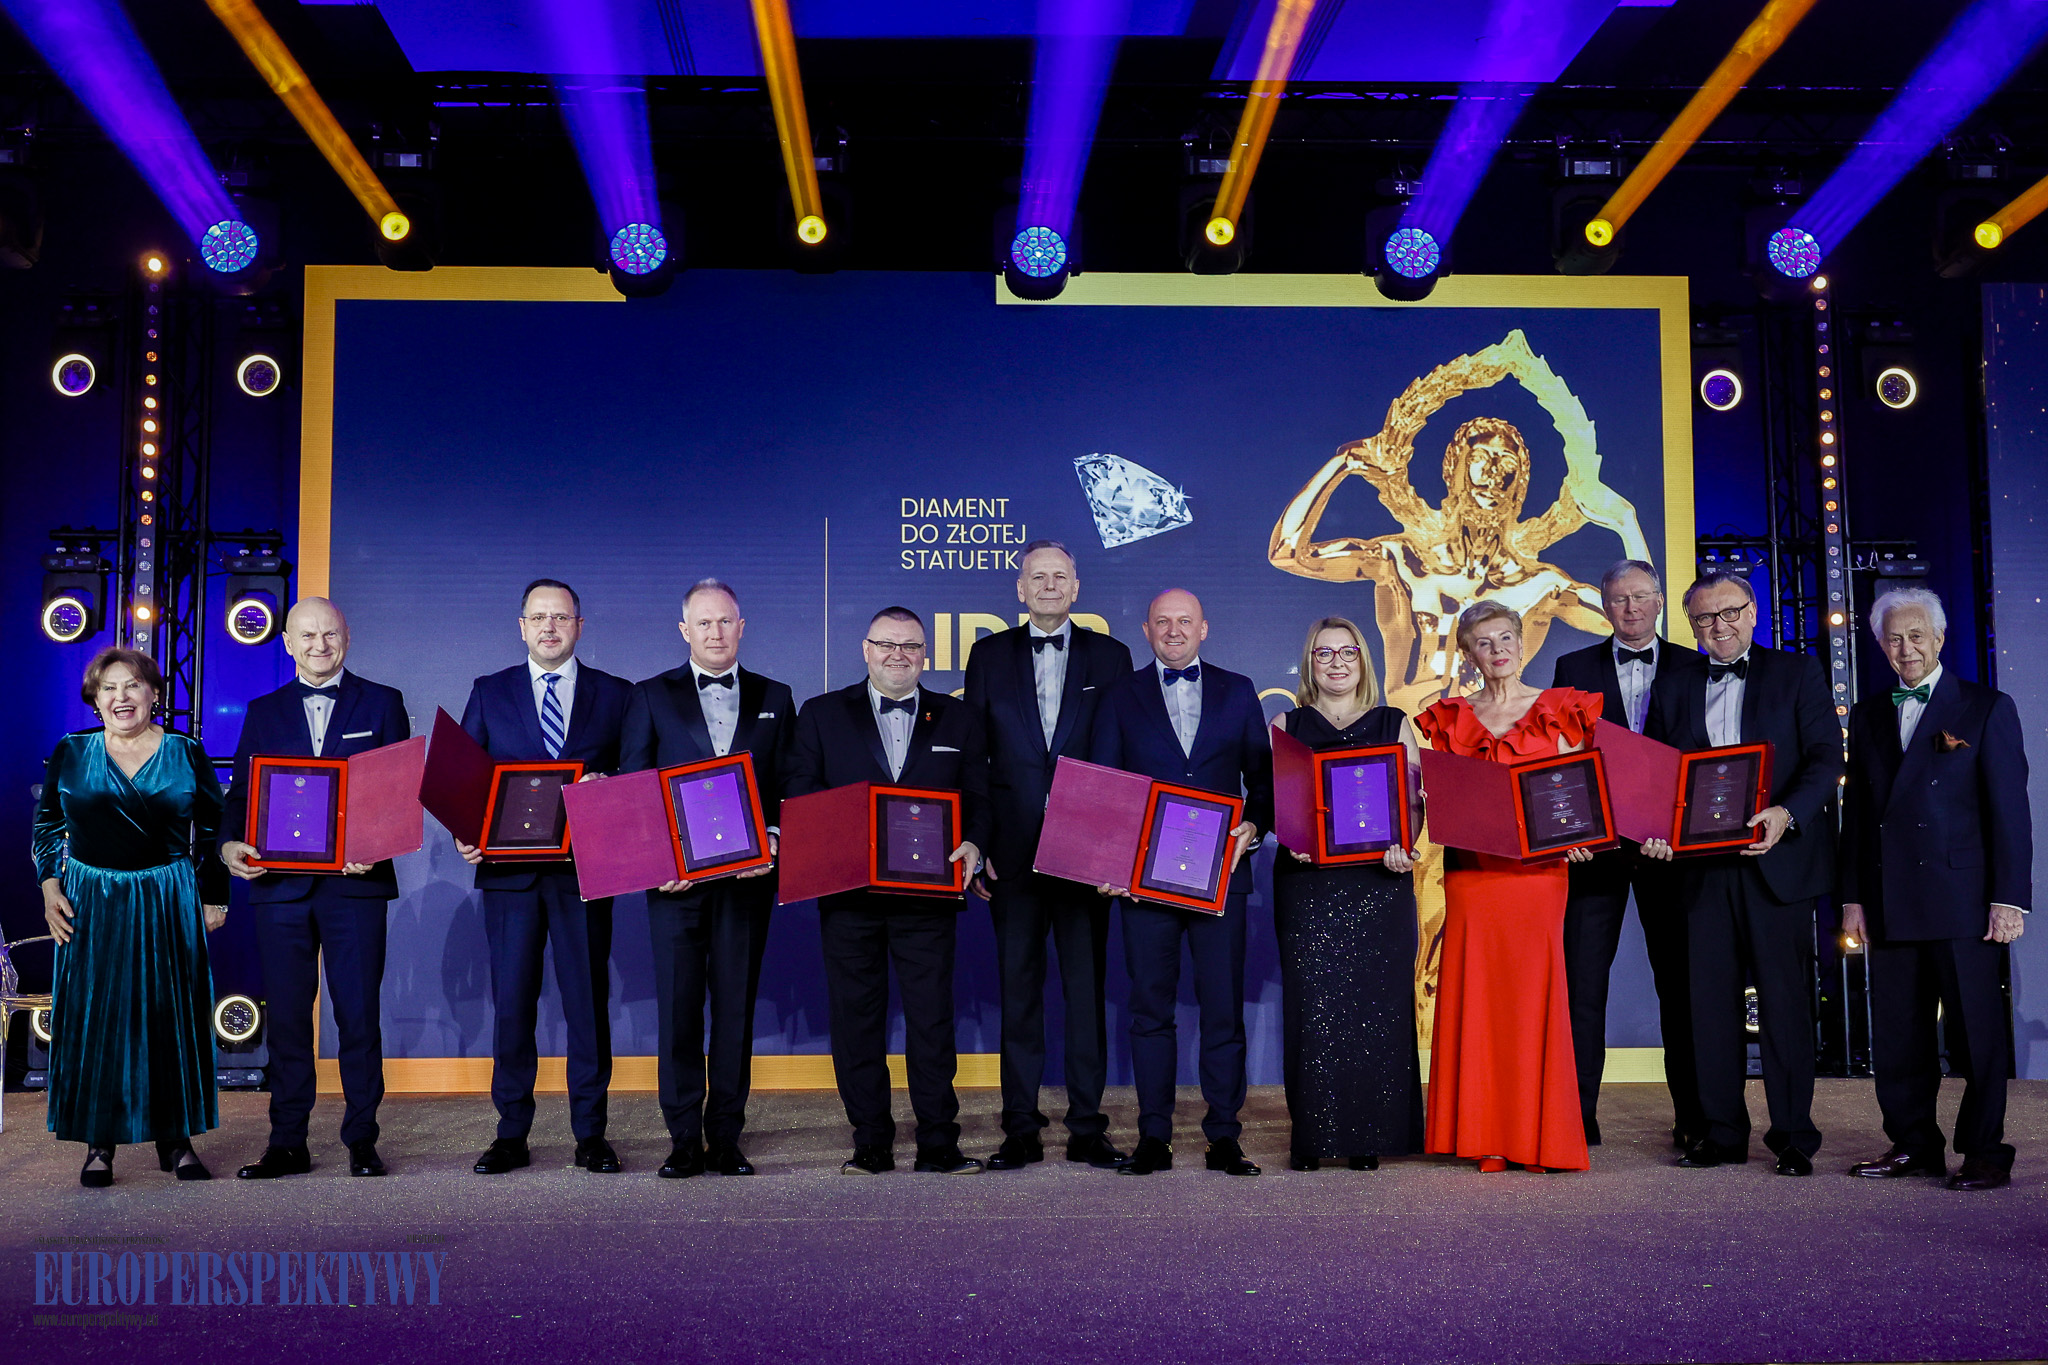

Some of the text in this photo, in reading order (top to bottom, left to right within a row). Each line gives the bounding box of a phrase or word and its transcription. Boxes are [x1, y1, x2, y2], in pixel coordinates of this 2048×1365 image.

[901, 498, 1010, 518] DIAMENT
[901, 524, 1026, 544] DO ZŁOTEJ
[901, 550, 1020, 570] STATUETK
